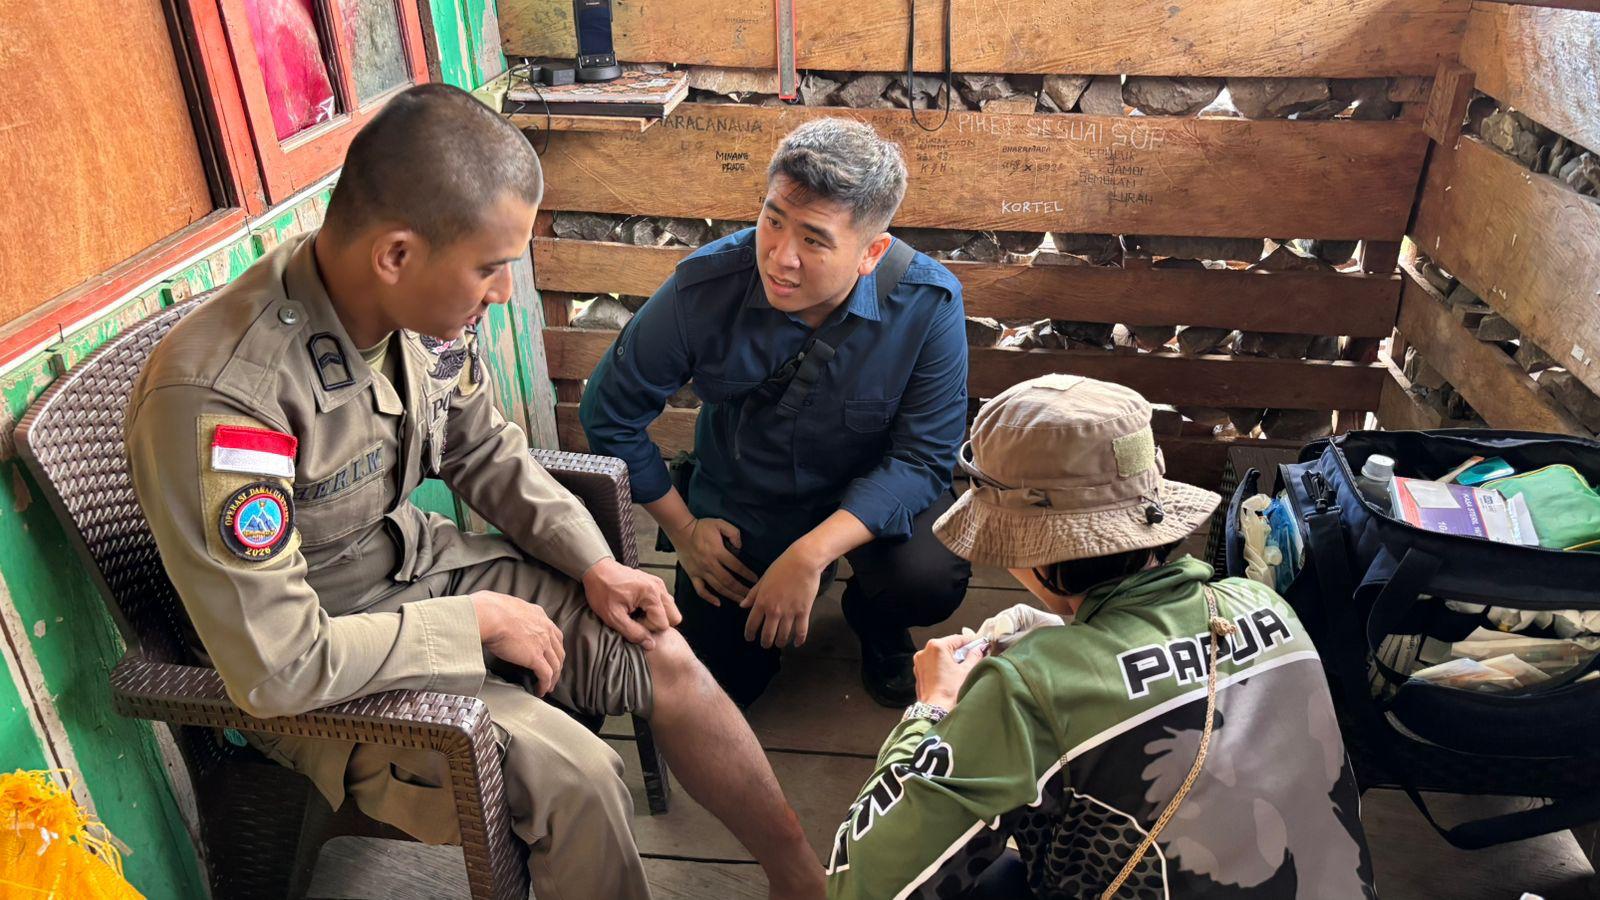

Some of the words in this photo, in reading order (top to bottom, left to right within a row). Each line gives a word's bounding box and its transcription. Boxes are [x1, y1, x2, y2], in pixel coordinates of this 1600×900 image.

[1001, 200, 1064, 214] KORTEL
[224, 492, 248, 526] OPERASI
[1116, 607, 1295, 700] PAPUA
